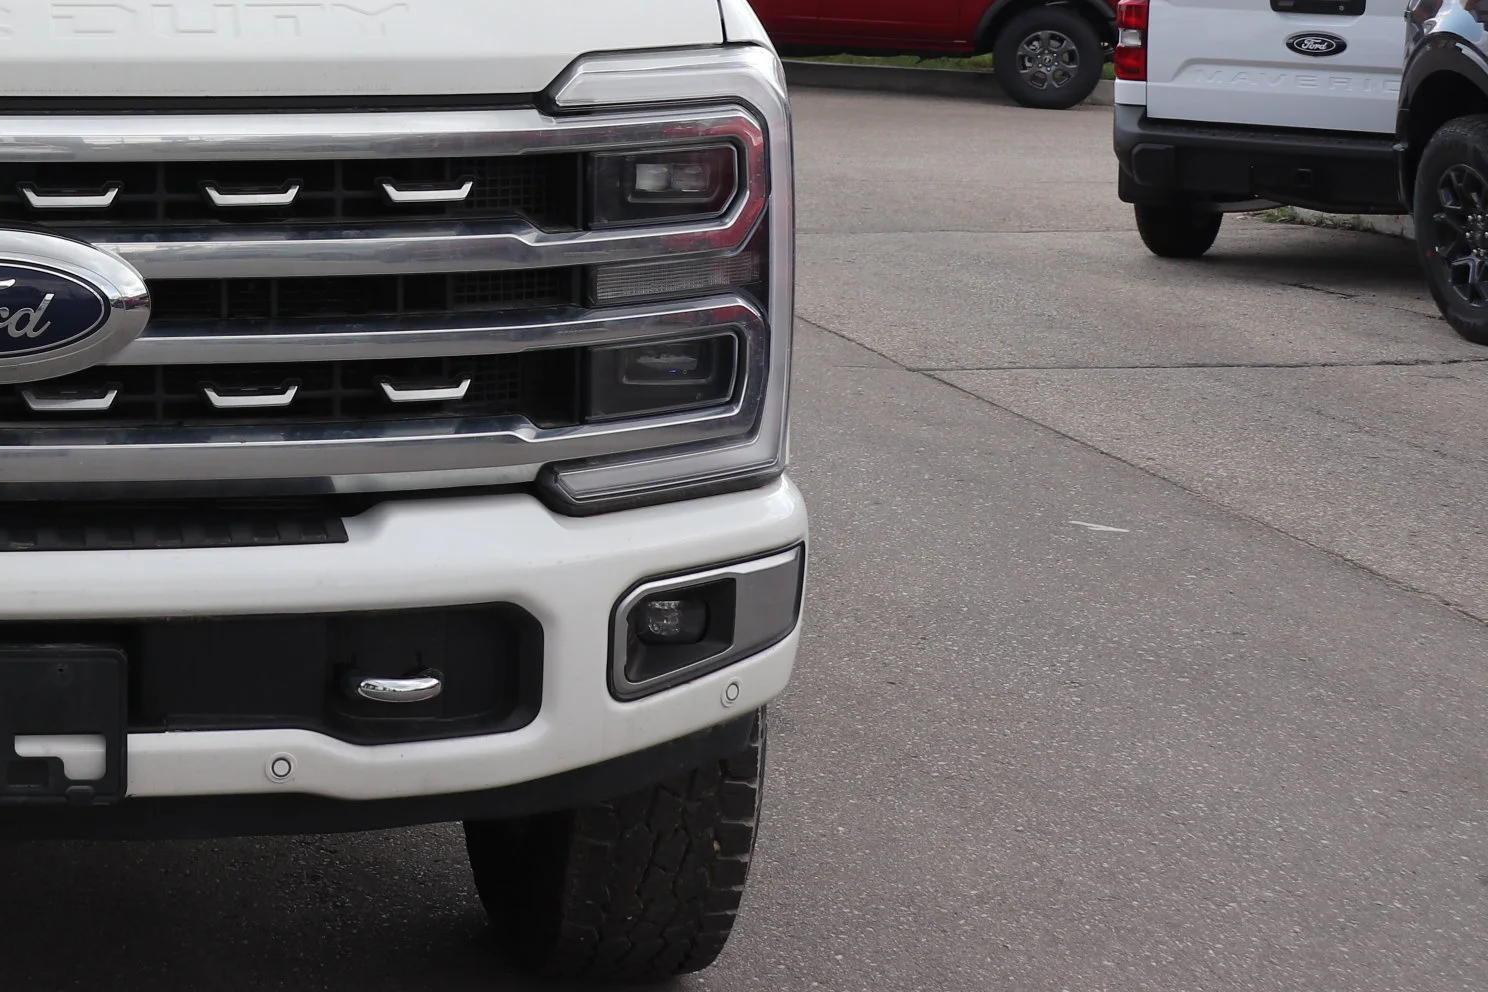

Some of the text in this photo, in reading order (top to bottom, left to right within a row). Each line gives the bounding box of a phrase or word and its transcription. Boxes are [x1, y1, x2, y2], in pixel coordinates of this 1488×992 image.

[50, 2, 409, 40] DUTY
[1301, 39, 1328, 50] Ford
[1195, 68, 1400, 93] MAVERIC
